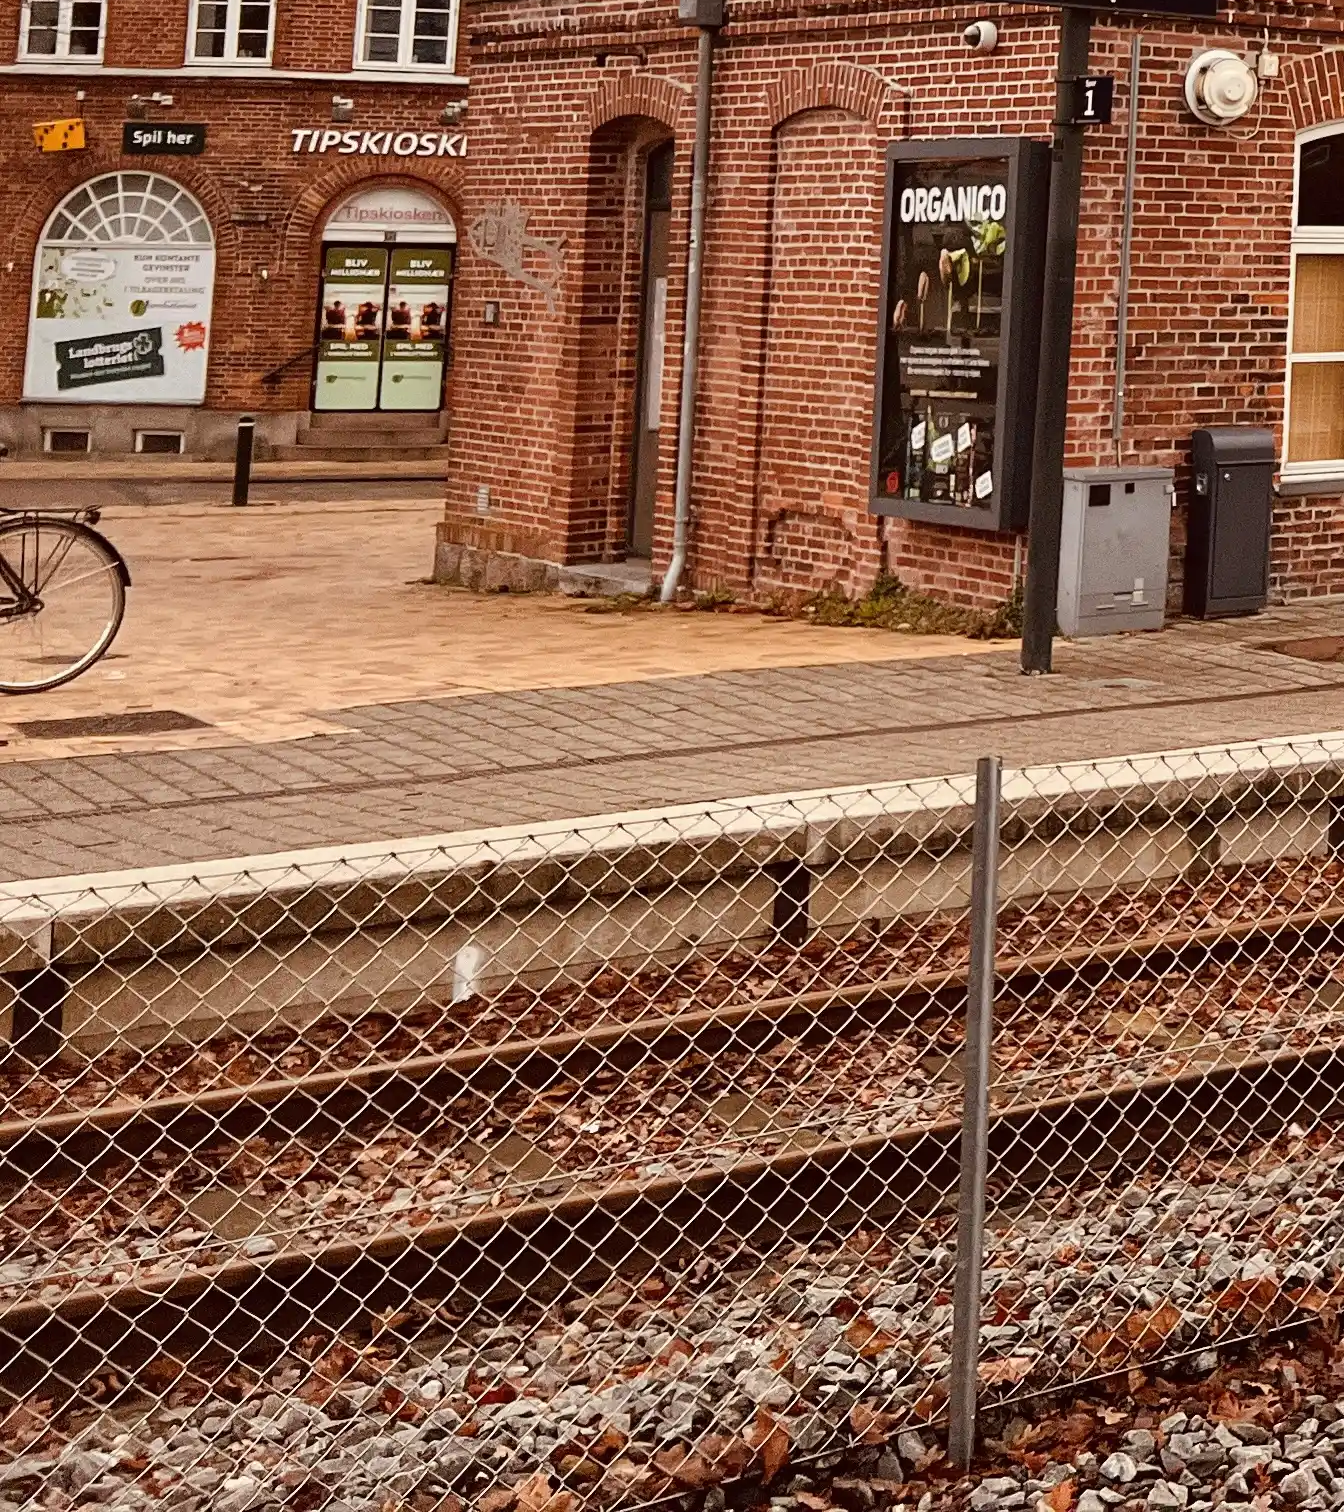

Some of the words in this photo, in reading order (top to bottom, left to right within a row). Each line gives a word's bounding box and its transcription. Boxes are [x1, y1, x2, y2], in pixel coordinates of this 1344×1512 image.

[1083, 90, 1095, 116] 1
[132, 130, 163, 148] Spil
[166, 130, 195, 145] her
[343, 207, 442, 221] Tipskiosken
[900, 184, 1007, 223] ORGANICO
